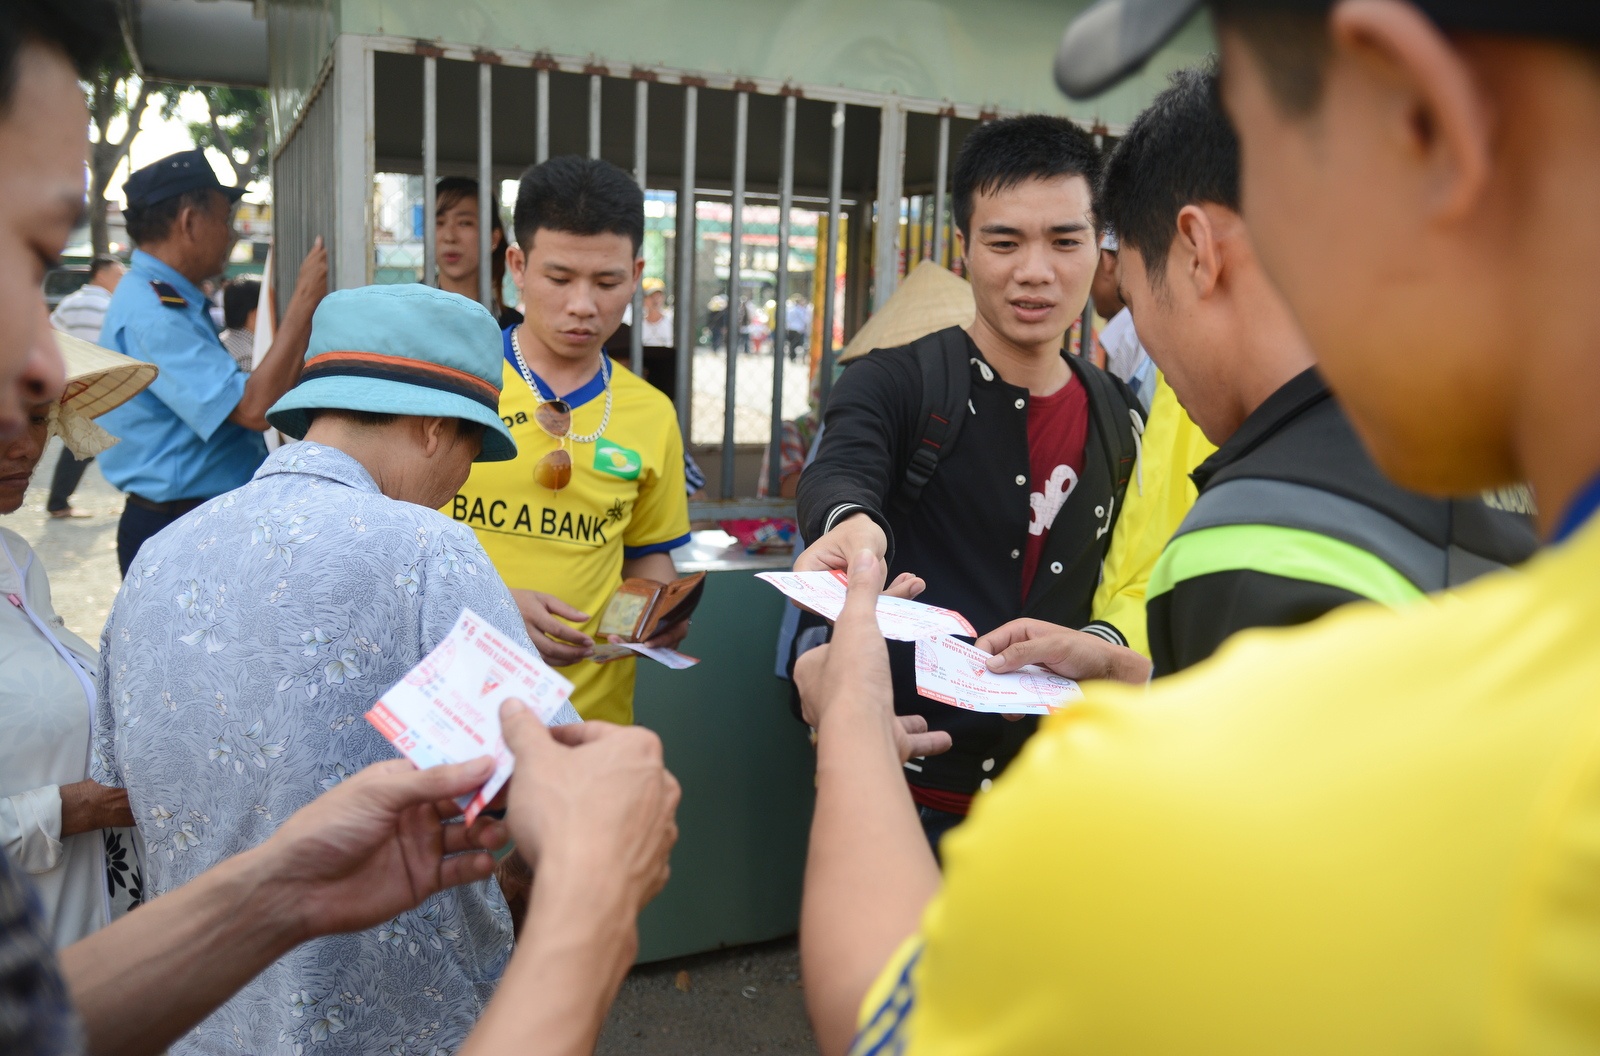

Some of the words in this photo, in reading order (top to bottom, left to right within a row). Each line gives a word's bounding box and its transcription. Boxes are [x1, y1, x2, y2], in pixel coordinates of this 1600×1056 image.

[452, 495, 507, 527] BAC
[513, 504, 532, 532] A
[541, 508, 608, 543] BANK
[941, 641, 963, 654] TOYOTA
[1047, 684, 1077, 693] TOYOTA
[960, 701, 975, 709] A2
[397, 733, 418, 753] A2
